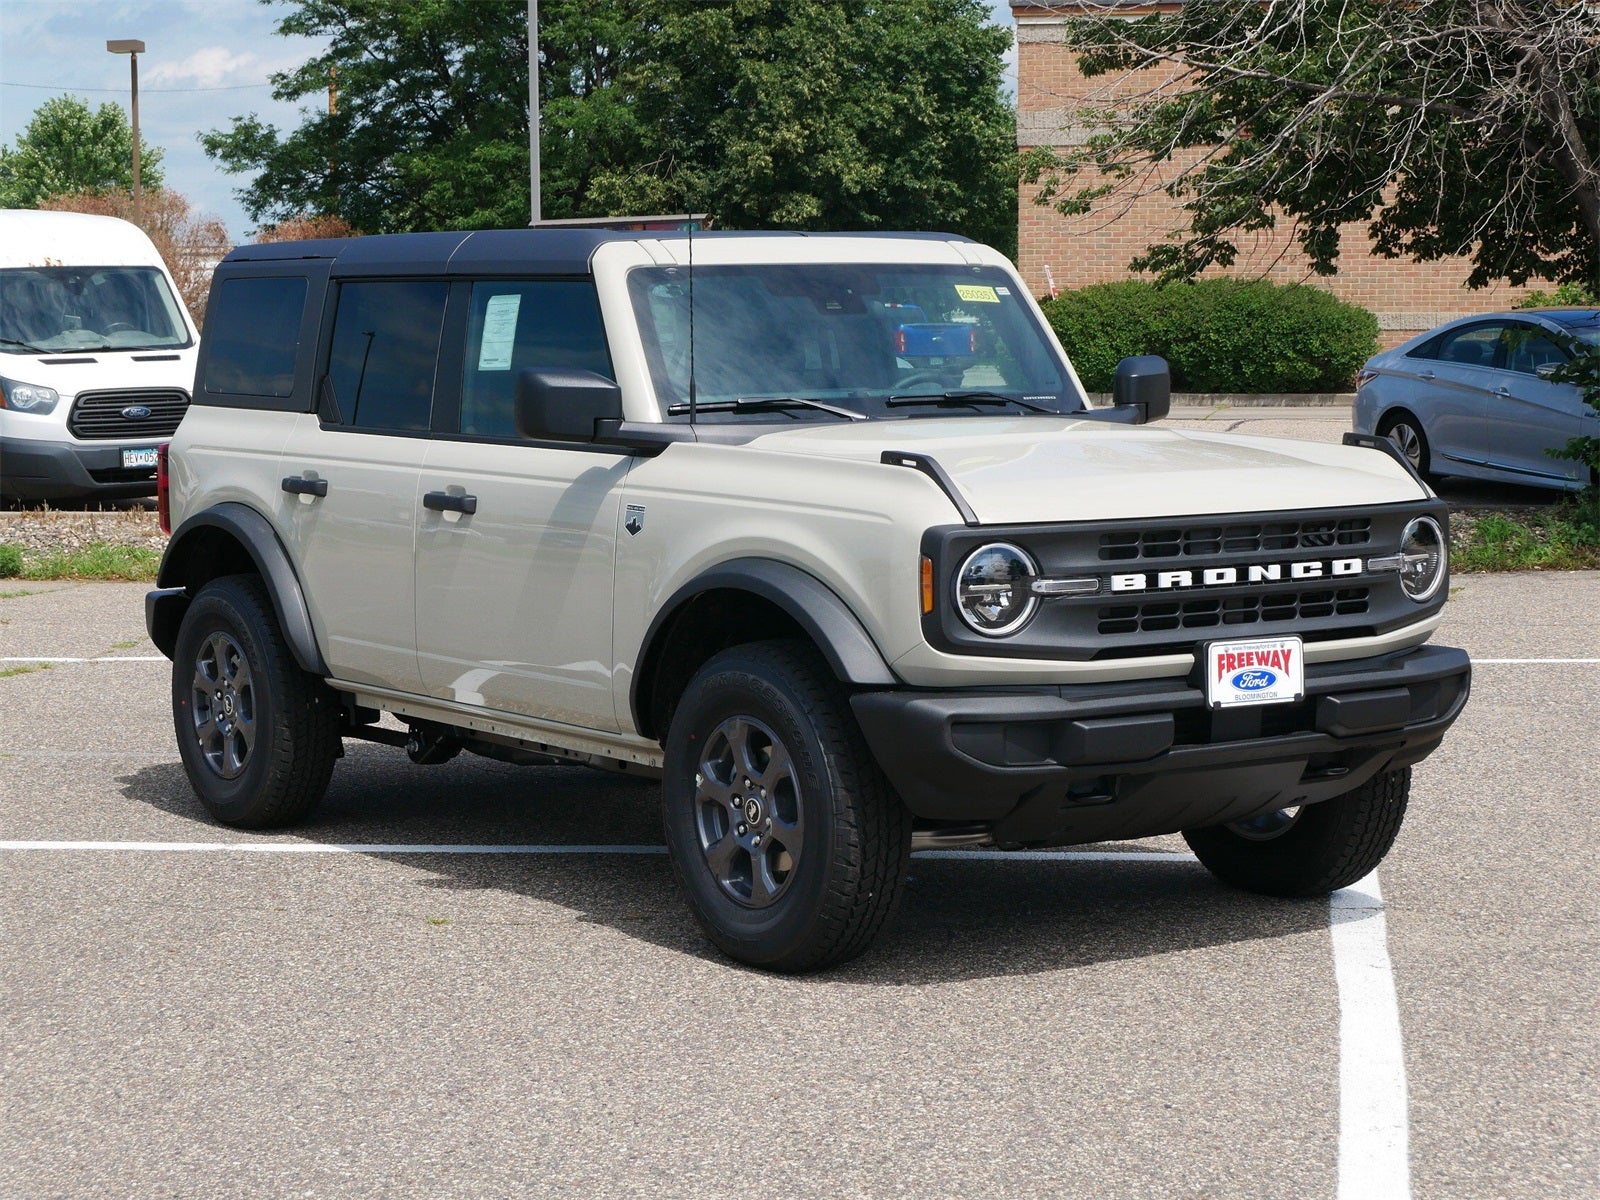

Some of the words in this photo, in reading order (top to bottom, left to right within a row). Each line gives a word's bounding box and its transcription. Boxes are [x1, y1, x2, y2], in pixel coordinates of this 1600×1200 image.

[124, 453, 139, 464] HEV
[1110, 558, 1362, 592] BRONCO
[1217, 648, 1293, 684] FREEWAY
[1240, 671, 1269, 688] Ford
[1234, 691, 1278, 701] BLOOMINGTON
